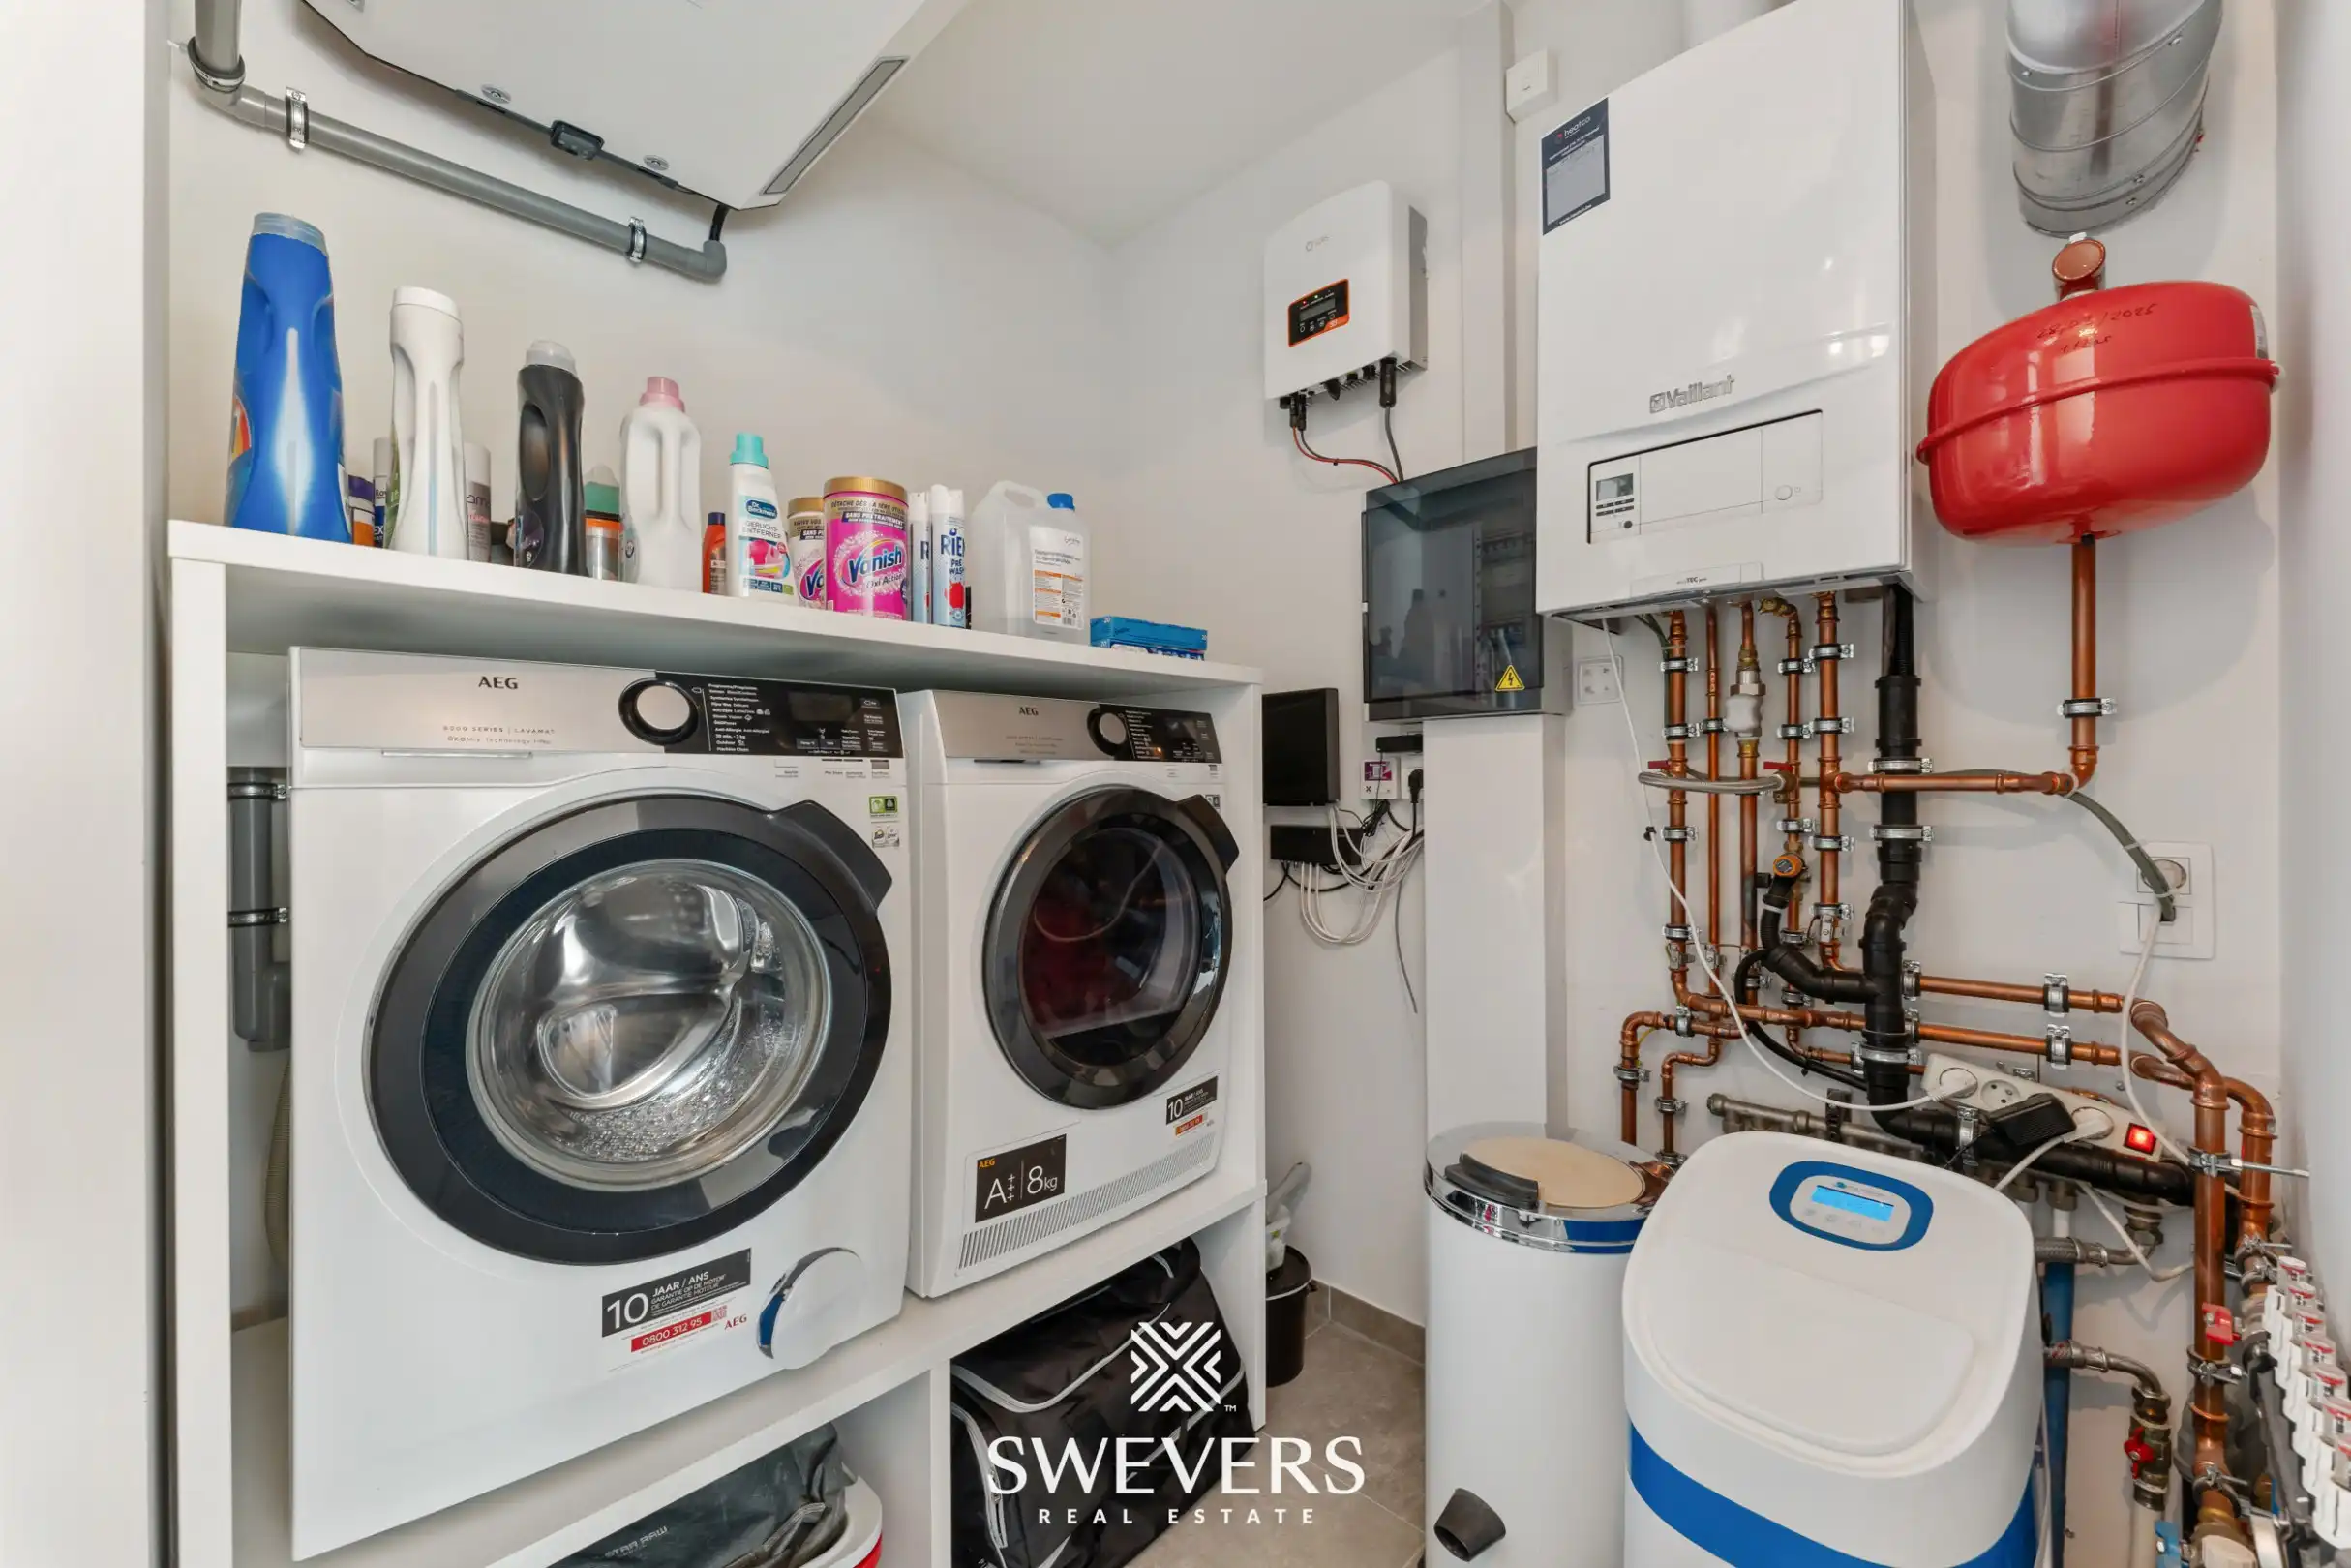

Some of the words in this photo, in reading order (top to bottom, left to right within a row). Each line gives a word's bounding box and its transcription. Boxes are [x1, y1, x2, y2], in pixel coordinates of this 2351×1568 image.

[1667, 375, 1734, 409] Vaillant
[849, 544, 902, 583] Vanish
[478, 676, 519, 690] AEG
[1019, 707, 1039, 716] AEG
[1167, 1099, 1183, 1121] 10
[979, 1159, 995, 1169] AEG
[652, 1281, 680, 1297] JAAR
[688, 1271, 709, 1285] ANS
[650, 1287, 682, 1305] GARANTIE
[607, 1292, 648, 1330] 10
[724, 1313, 747, 1330] AEG
[642, 1329, 670, 1345] 0800
[673, 1323, 689, 1336] 312
[690, 1317, 702, 1328] 95
